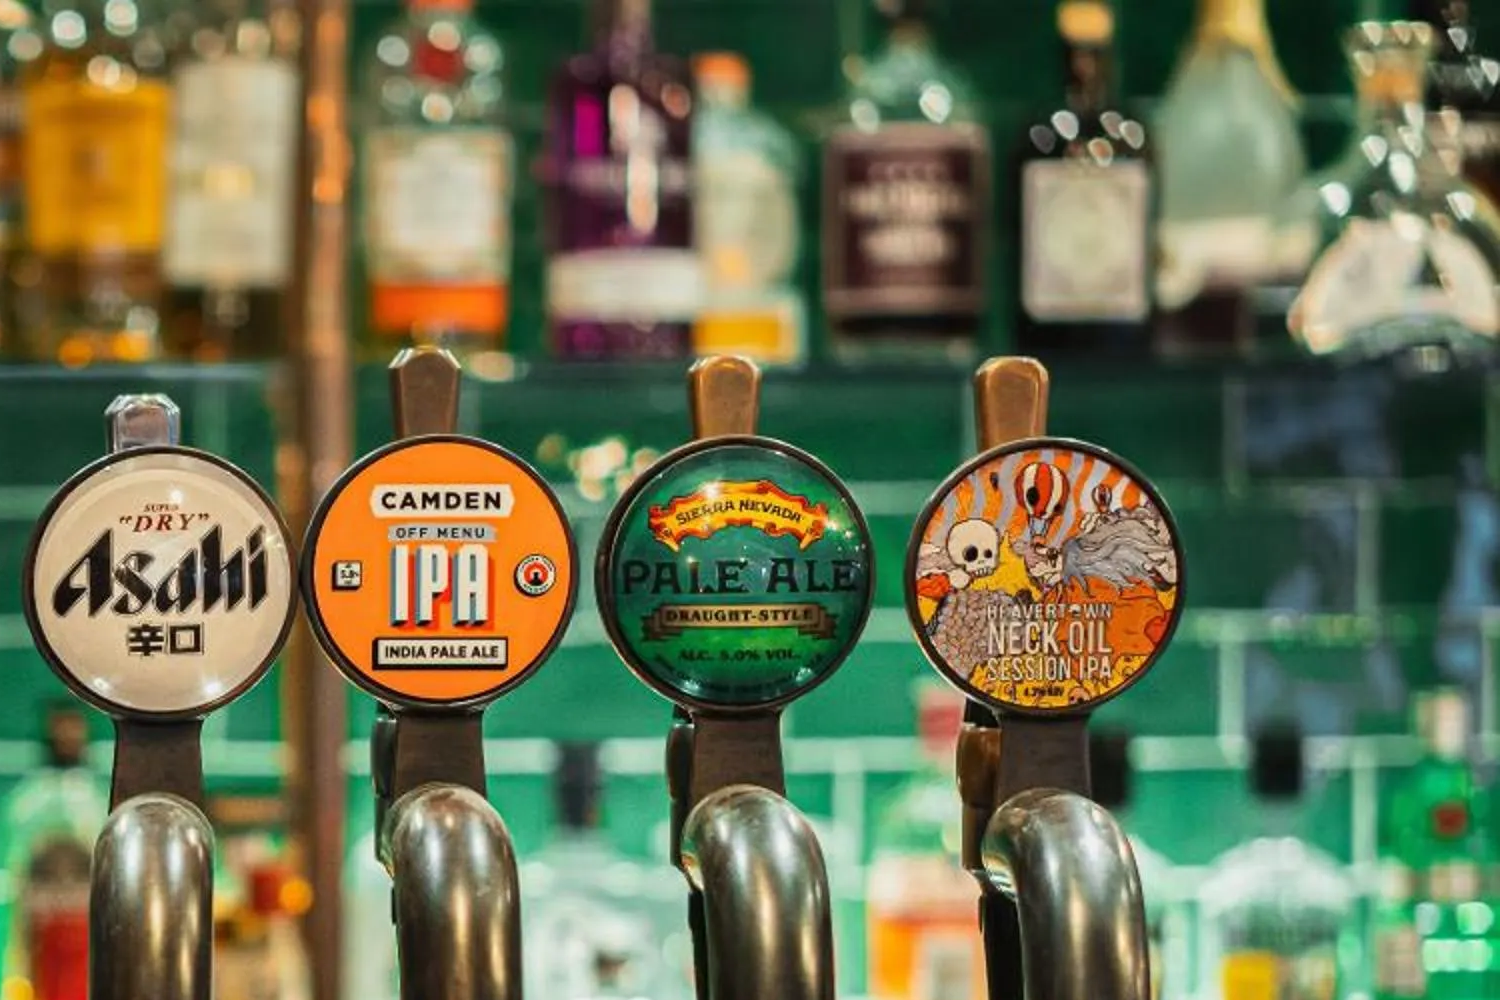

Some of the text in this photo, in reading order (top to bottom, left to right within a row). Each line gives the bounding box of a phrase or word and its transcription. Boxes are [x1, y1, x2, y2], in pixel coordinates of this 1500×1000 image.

[381, 491, 502, 510] CAMDEN
[675, 499, 802, 525] SIERRA NEVADA
[396, 527, 486, 539] OFF MENU
[53, 523, 268, 618] Asahi
[621, 557, 858, 595] PALE ALE
[391, 543, 491, 628] IPA
[666, 608, 814, 622] DRAUGHT-STYLE
[128, 622, 205, 657] 辛口
[987, 620, 1113, 655] NECK OIL
[384, 646, 499, 658] INDIA PALE ALE
[987, 655, 1112, 681] SESSION IPA
